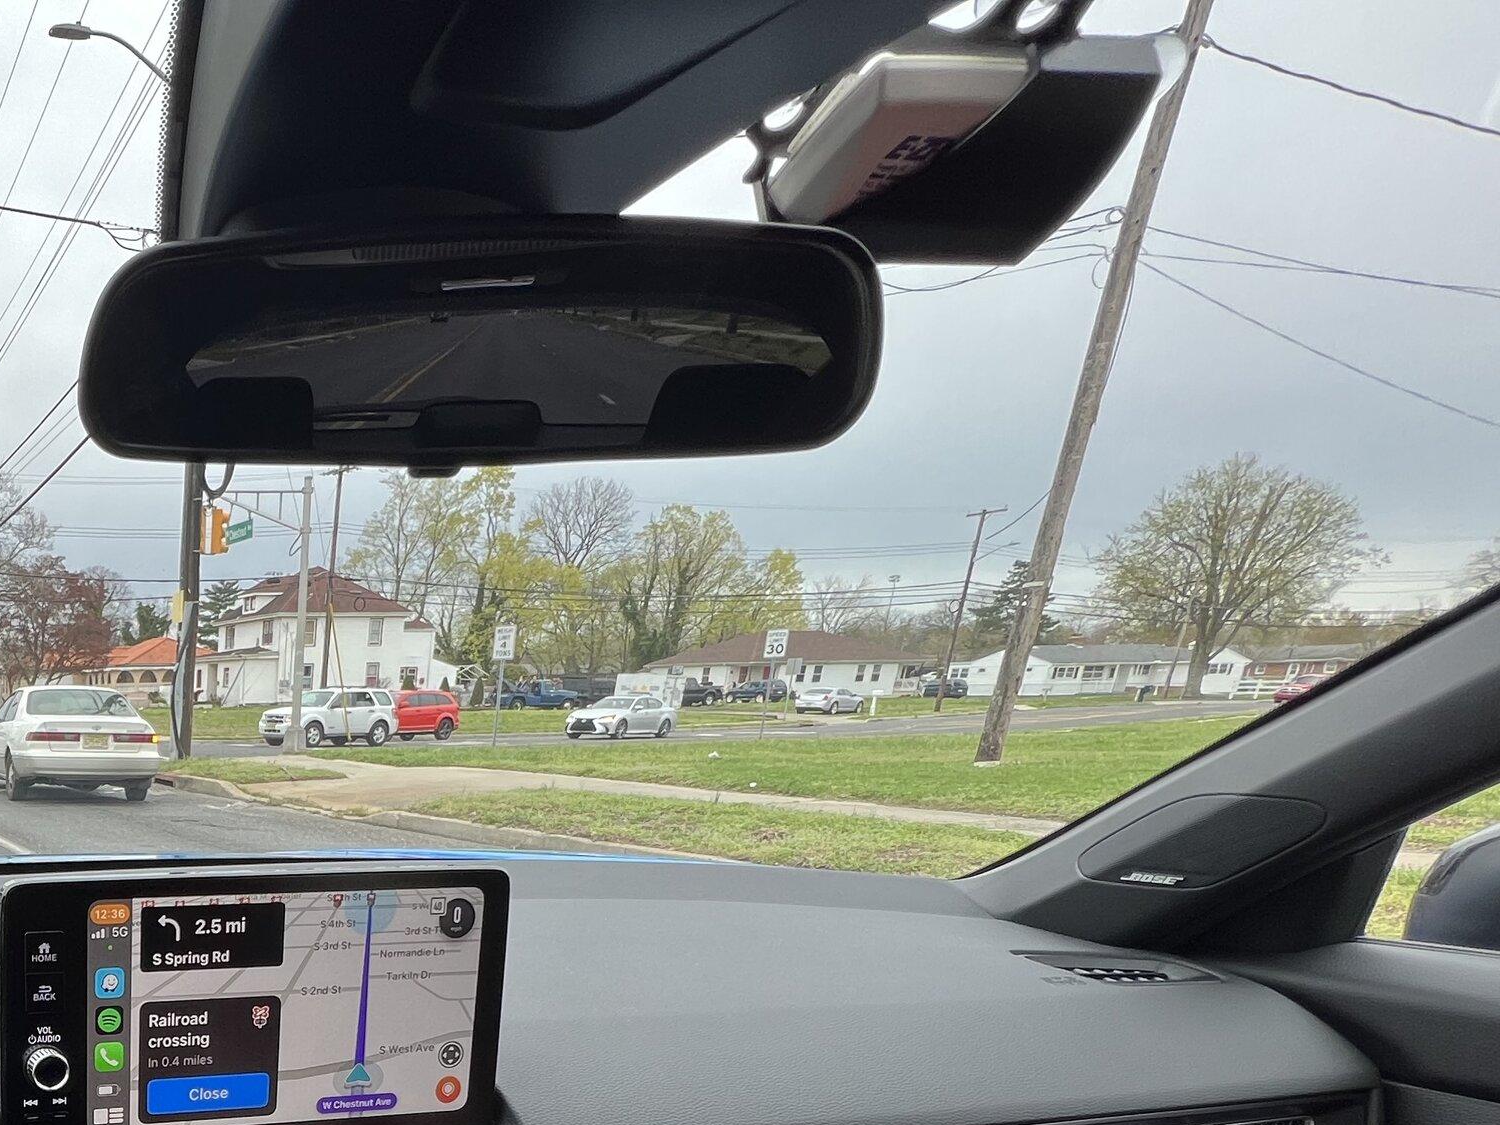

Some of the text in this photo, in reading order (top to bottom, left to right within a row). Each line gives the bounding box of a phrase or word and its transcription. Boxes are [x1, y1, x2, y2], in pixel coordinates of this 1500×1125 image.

[766, 643, 784, 655] 30
[95, 909, 126, 920] 12:36
[453, 906, 461, 924] 0
[194, 917, 246, 936] 2.5 mi
[328, 920, 344, 928] 4th
[347, 919, 356, 928] St
[111, 926, 129, 938] 5G
[404, 926, 432, 935] 3rd St
[323, 942, 339, 950] 3rd
[341, 942, 351, 950] St
[380, 947, 445, 958] Normandie Ln
[31, 954, 57, 963] HOME
[152, 950, 230, 967] S Spring Rd
[421, 971, 432, 980] Dr
[301, 985, 342, 995] S 2nd St
[33, 993, 56, 1002] BACK
[148, 1011, 209, 1028] Railroad
[37, 1026, 52, 1034] VOL
[37, 1035, 61, 1044] AUDIO
[148, 1033, 210, 1049] crossing
[379, 1044, 435, 1055] S West Ave
[148, 1054, 213, 1068] In 0.4 miles
[189, 1087, 229, 1101] Close
[322, 1098, 392, 1110] W Chestnut Ave
